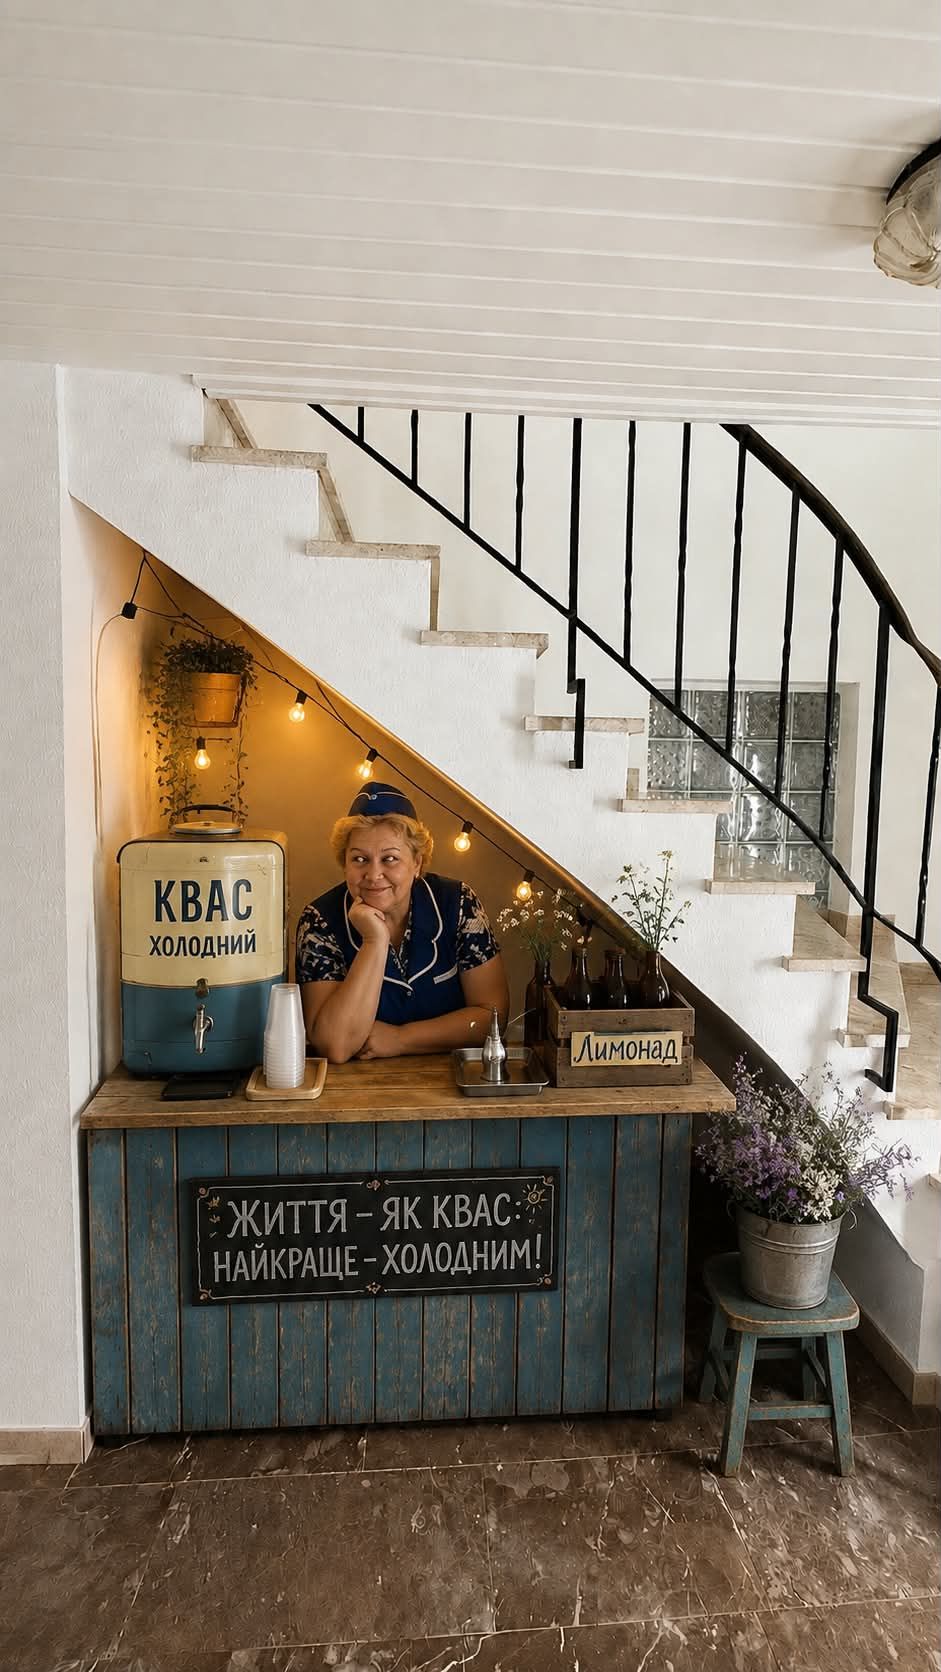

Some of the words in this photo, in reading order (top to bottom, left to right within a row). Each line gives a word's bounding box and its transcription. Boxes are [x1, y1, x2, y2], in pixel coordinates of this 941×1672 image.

[154, 879, 253, 923] КВАС
[149, 929, 256, 958] ХОЛОДНИЙ
[573, 1034, 678, 1064] Лимонад
[226, 1198, 348, 1238] ЖИТТЯ
[380, 1195, 423, 1232] ЯК
[432, 1191, 522, 1230] КВАС:
[213, 1241, 359, 1283] НАЙКРАЩЕ
[381, 1233, 542, 1276] ХОЛОДНИМ!
